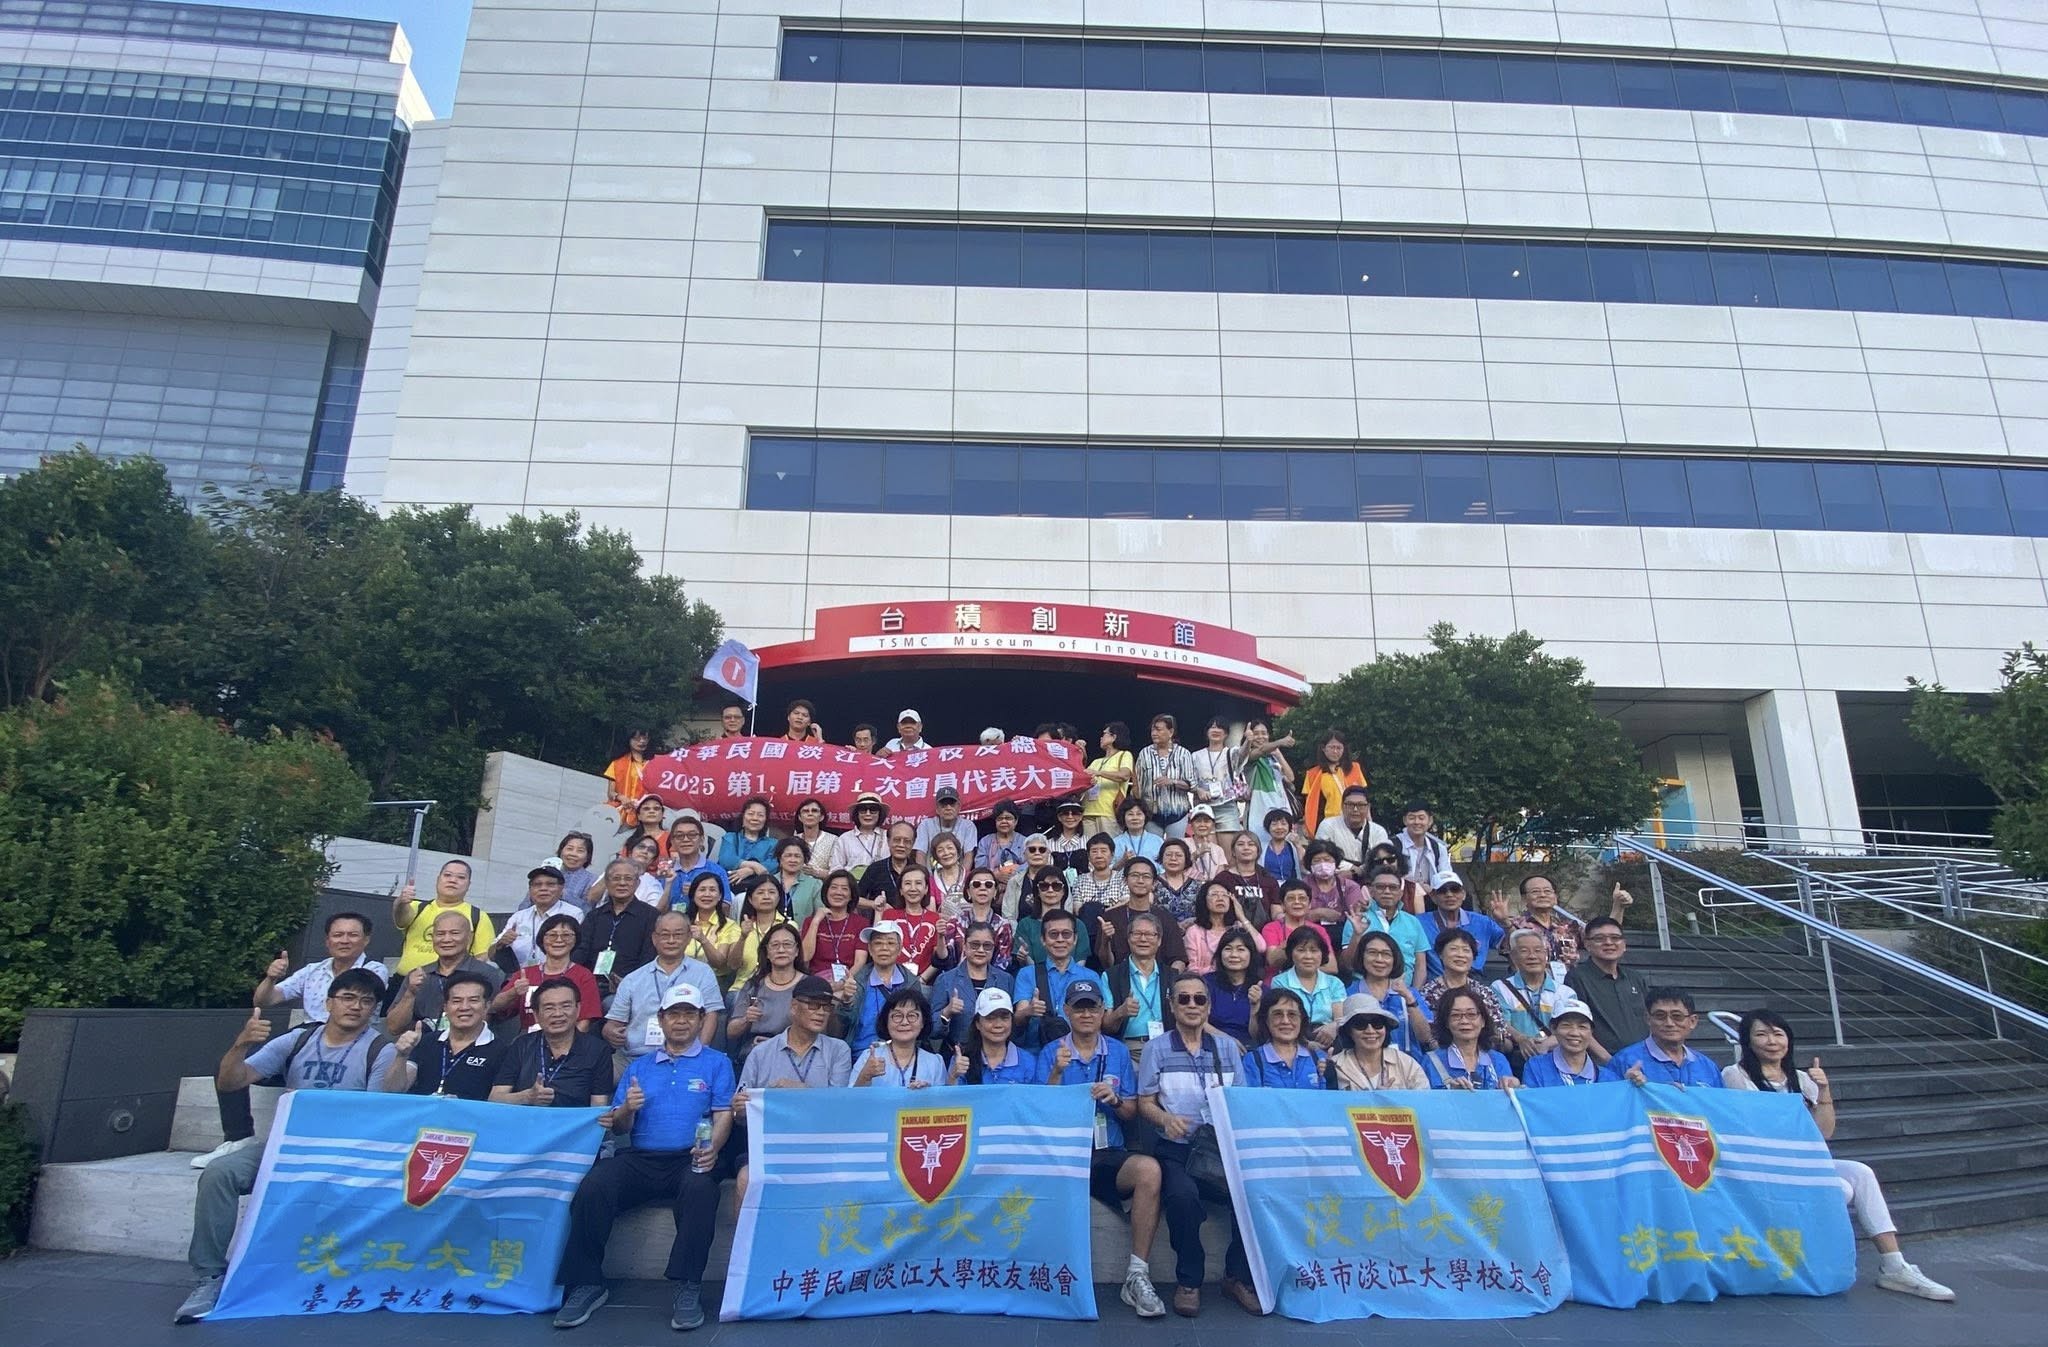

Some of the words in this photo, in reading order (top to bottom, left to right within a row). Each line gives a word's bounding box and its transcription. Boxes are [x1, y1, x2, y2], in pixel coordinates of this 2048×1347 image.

[880, 604, 1197, 647] 台積創新館
[879, 637, 929, 648] TSMC
[953, 636, 1034, 648] Museum
[1059, 639, 1077, 650] of
[1095, 642, 1200, 664] Innovation
[658, 770, 716, 796] 2025
[303, 1060, 348, 1084] TKU
[466, 1056, 487, 1065] EA7
[902, 1115, 931, 1125] TAMKANG
[932, 1113, 968, 1124] UNIVERSITY
[819, 1189, 1034, 1258] 淡江大學
[1303, 1189, 1506, 1250] 淡江大學
[297, 1231, 526, 1290] 淡江大學
[772, 1256, 1079, 1302] 中華民國淡江大學校友總會
